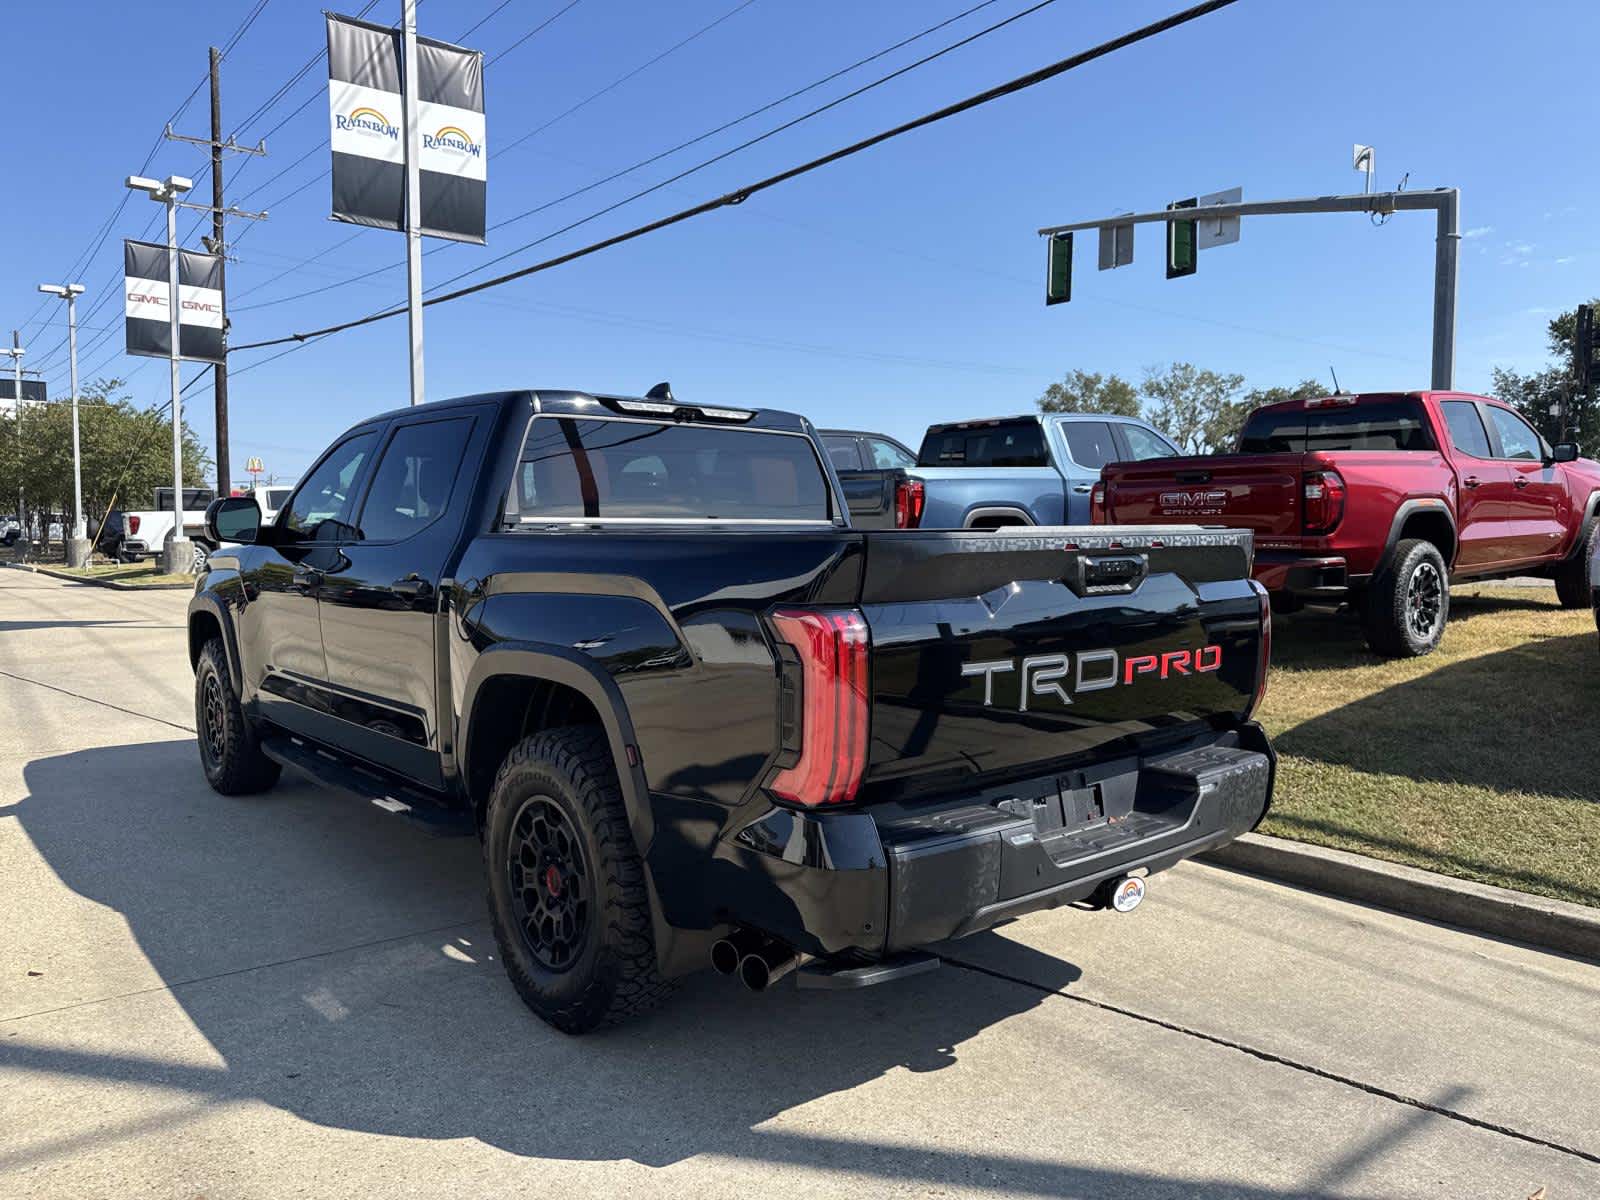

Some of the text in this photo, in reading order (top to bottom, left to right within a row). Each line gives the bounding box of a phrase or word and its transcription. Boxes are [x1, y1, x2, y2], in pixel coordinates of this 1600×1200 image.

[335, 114, 400, 141] RAINBOW
[422, 134, 482, 158] RAINBOW
[127, 293, 169, 307] GMC
[181, 300, 221, 314] GMC
[1159, 491, 1226, 507] GMC
[960, 644, 1222, 712] TRD PRO
